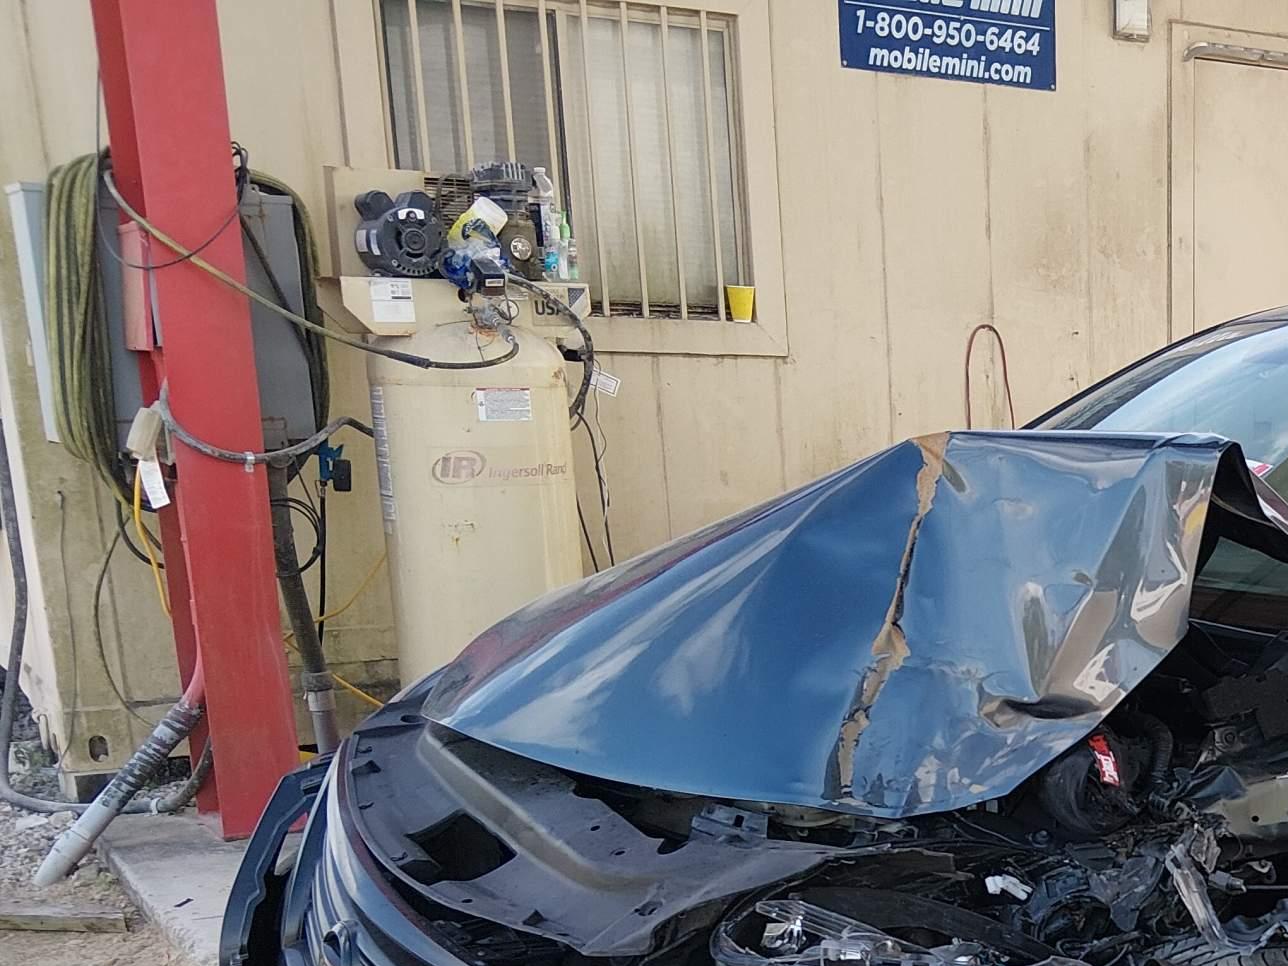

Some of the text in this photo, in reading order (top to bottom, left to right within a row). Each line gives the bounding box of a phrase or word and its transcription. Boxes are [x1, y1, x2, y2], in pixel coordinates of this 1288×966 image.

[856, 9, 1041, 56] 1-800-950-6464
[868, 46, 1033, 85] mobilemini.com
[488, 463, 544, 480] Ingersoll
